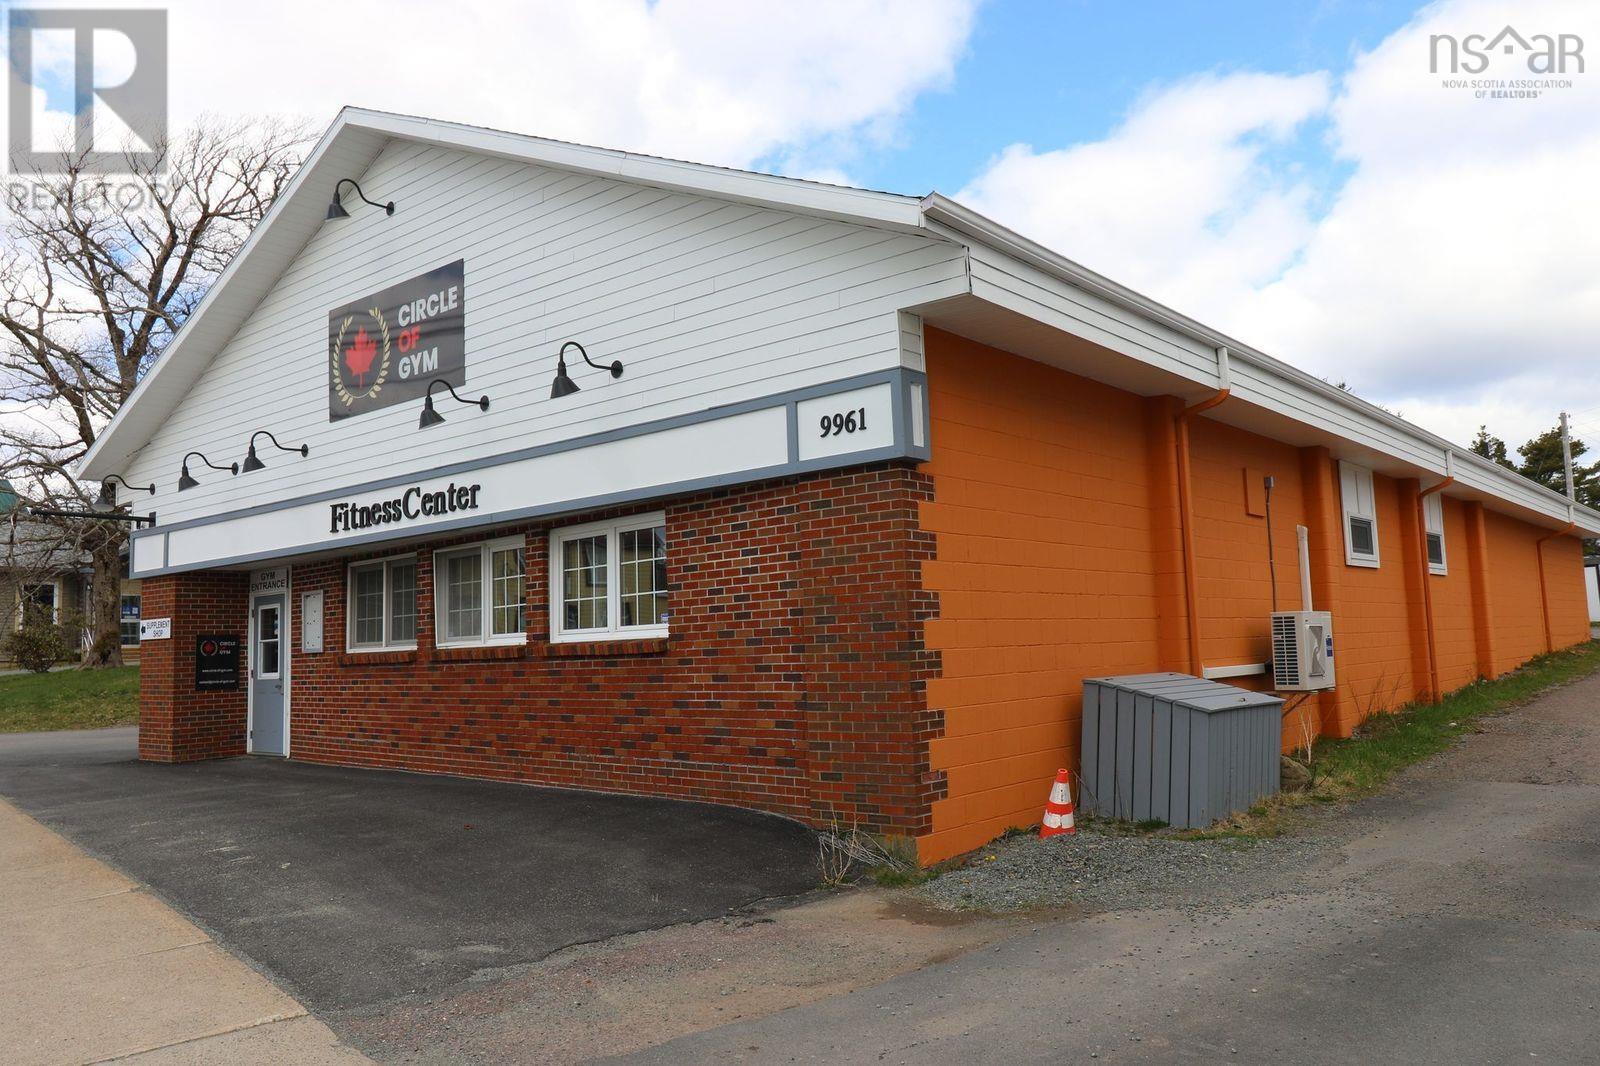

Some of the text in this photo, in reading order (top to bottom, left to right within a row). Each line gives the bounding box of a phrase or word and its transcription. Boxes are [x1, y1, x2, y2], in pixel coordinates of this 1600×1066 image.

[397, 285, 458, 327] CIRCLE
[397, 325, 421, 353] OF
[398, 346, 438, 379] GYM
[820, 407, 867, 438] 9961
[251, 579, 286, 592] ENTRANCE
[260, 571, 276, 581] GYM
[146, 620, 170, 630] SUPPLEMENT
[152, 629, 163, 638] SHOP
